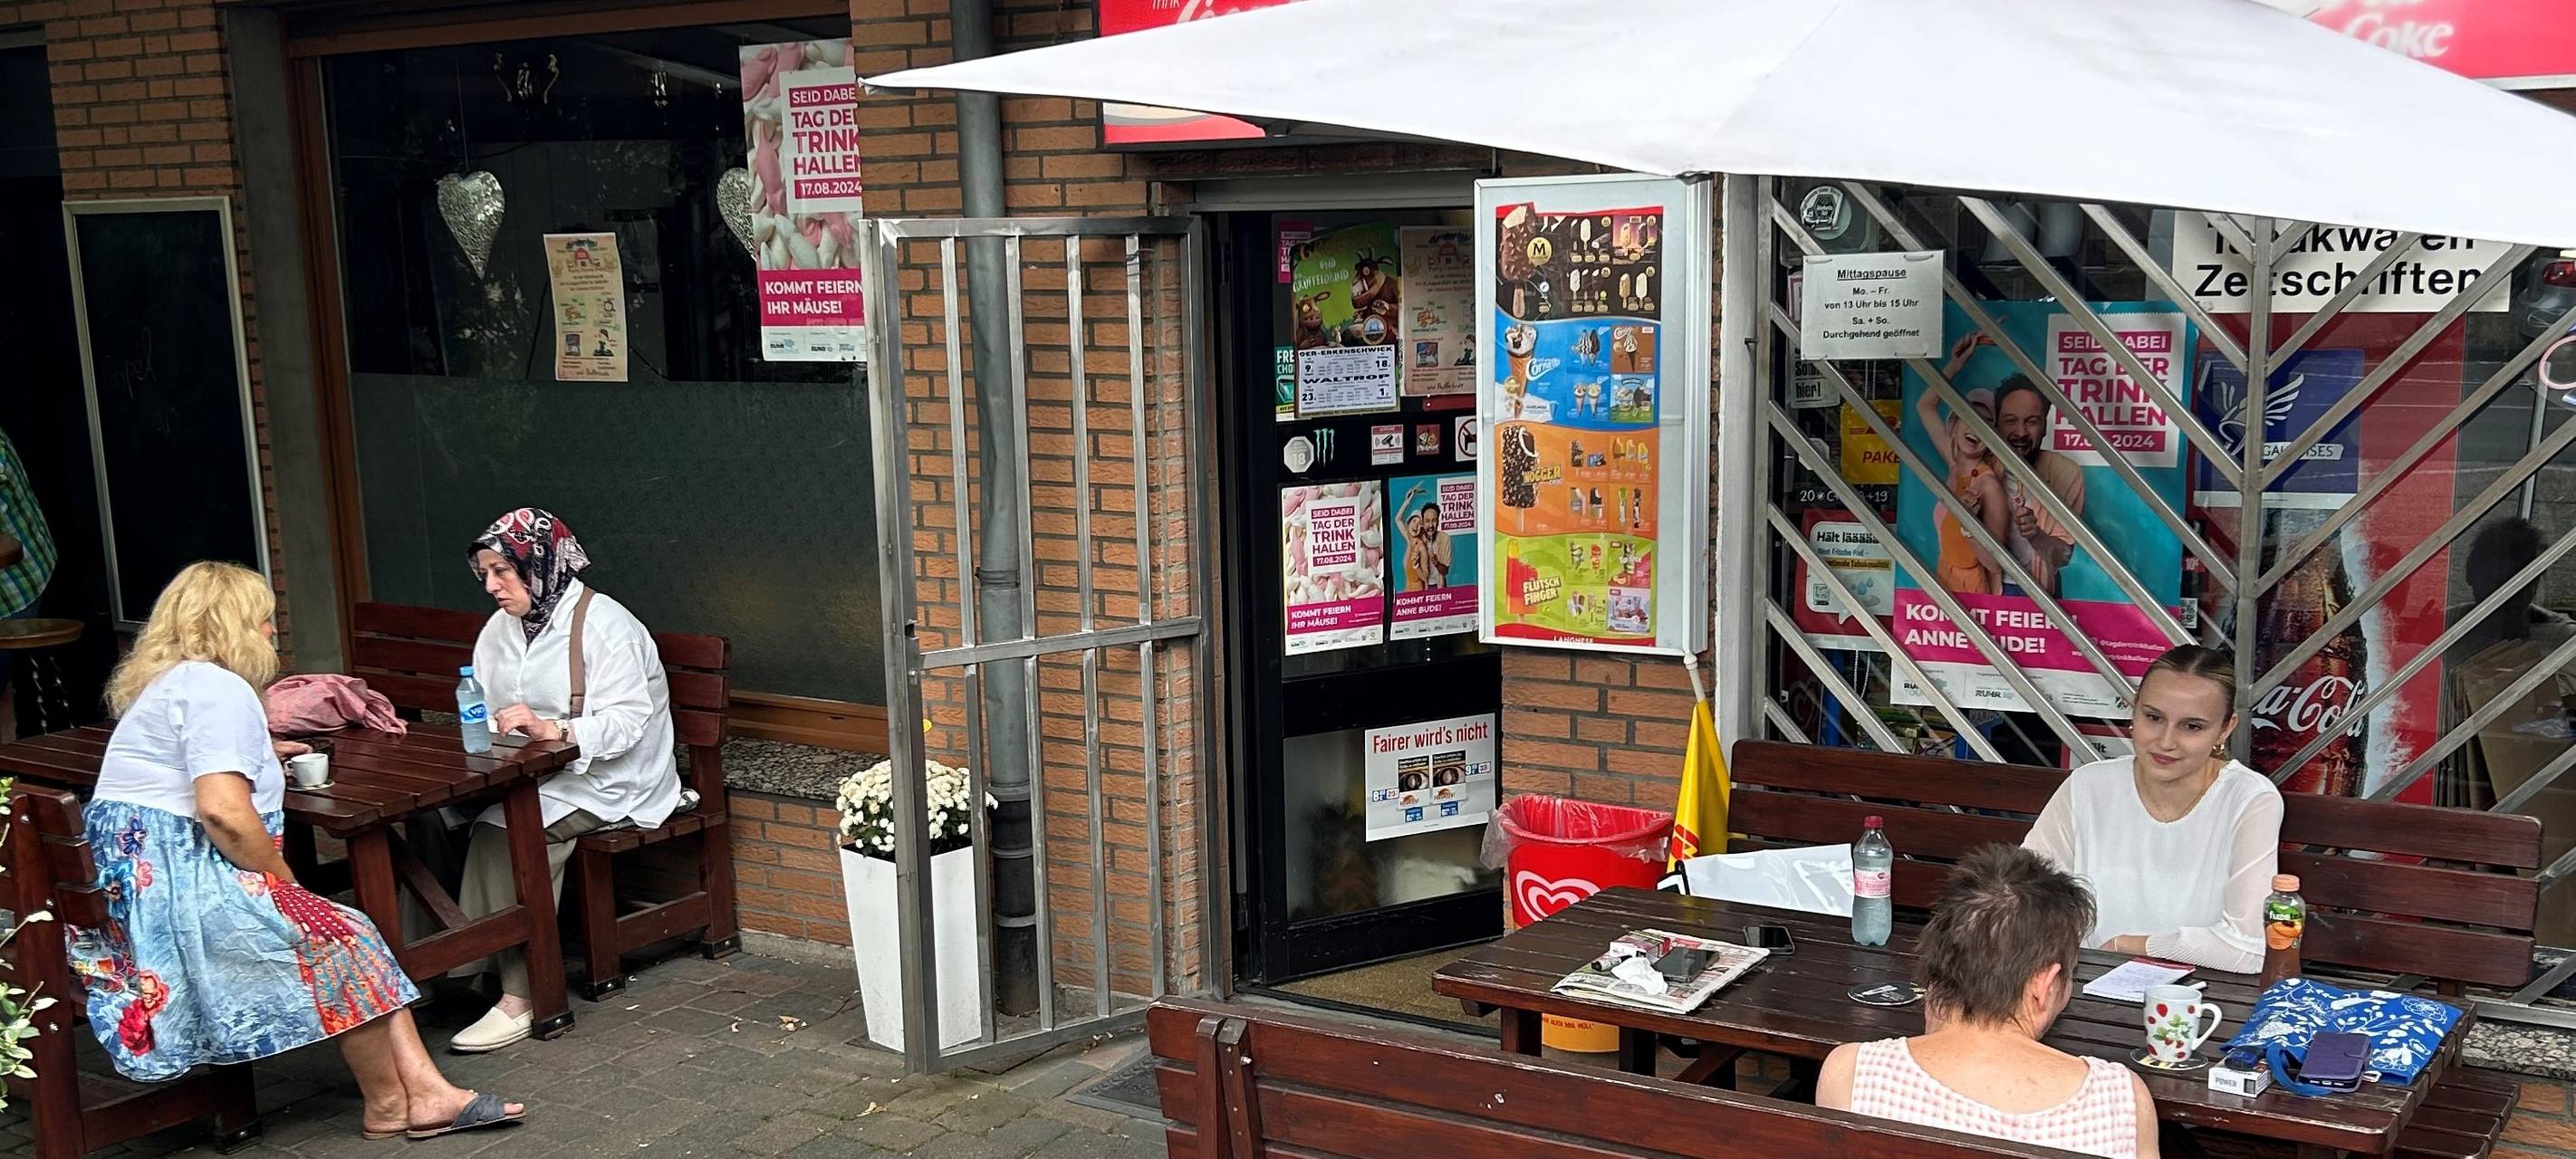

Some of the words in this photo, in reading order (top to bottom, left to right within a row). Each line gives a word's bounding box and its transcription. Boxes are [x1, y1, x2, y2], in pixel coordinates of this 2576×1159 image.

[792, 90, 821, 104] SEID
[824, 88, 856, 102] DABE
[791, 110, 824, 128] TAG
[793, 129, 860, 154] TRINK
[800, 180, 862, 196] 17.08.2024
[1533, 243, 1546, 255] M
[1837, 268, 1907, 280] Mittagspause
[764, 281, 813, 295] KOMMT
[816, 280, 863, 294] FEIERN
[1852, 287, 1868, 295] Mo.
[1879, 286, 1890, 294] Fr.
[767, 301, 790, 314] IHR
[793, 297, 842, 314] MÄUSE!
[1844, 301, 1853, 309] 13
[1856, 300, 1871, 309] Uhr
[1874, 300, 1888, 308] bis
[1890, 299, 1900, 308] 15
[1903, 299, 1919, 308] Uhr
[1852, 317, 1866, 325] Sa.
[1876, 316, 1890, 325] So.
[1822, 330, 1880, 340] Durchgehend
[1883, 329, 1920, 340] geöffnet
[2125, 335, 2166, 350] ABEI
[1276, 350, 1294, 364] FRE
[1299, 346, 1392, 358] OER-ERKENSCHWICK
[2060, 357, 2108, 376] TAG
[1302, 373, 1390, 384] WALTROP
[1795, 381, 1821, 398] hier!
[1862, 450, 1900, 465] PAKE
[1522, 465, 1562, 484] NOGGER
[1441, 493, 1456, 502] TAG
[1441, 500, 1474, 512] TRINK
[1441, 510, 1475, 521] HALLEN
[1312, 520, 1331, 531] TAG
[1333, 518, 1355, 528] DER
[1312, 528, 1355, 543] TRINK
[1816, 531, 1840, 543] Hält
[1312, 541, 1356, 555] HALLEN
[1523, 577, 1561, 593] FLUTSCH
[1396, 596, 1425, 607] KOMMT
[1426, 592, 1452, 603] FEIERN
[1523, 589, 1559, 606] FINGER
[1292, 608, 1322, 620] KOMMT
[1322, 605, 1352, 617] FEIERN
[1396, 606, 1418, 617] ANNE
[1291, 620, 1306, 630] IHR
[1995, 609, 2078, 630] FEIER
[1904, 628, 1969, 649] ANNE
[1984, 635, 2046, 654] UDE!
[1975, 689, 2002, 699] RUHR
[1373, 733, 1411, 753] Fairer
[1415, 725, 1453, 748] wird's
[1456, 721, 1488, 742] nicht
[2215, 1076, 2237, 1087] POWER
